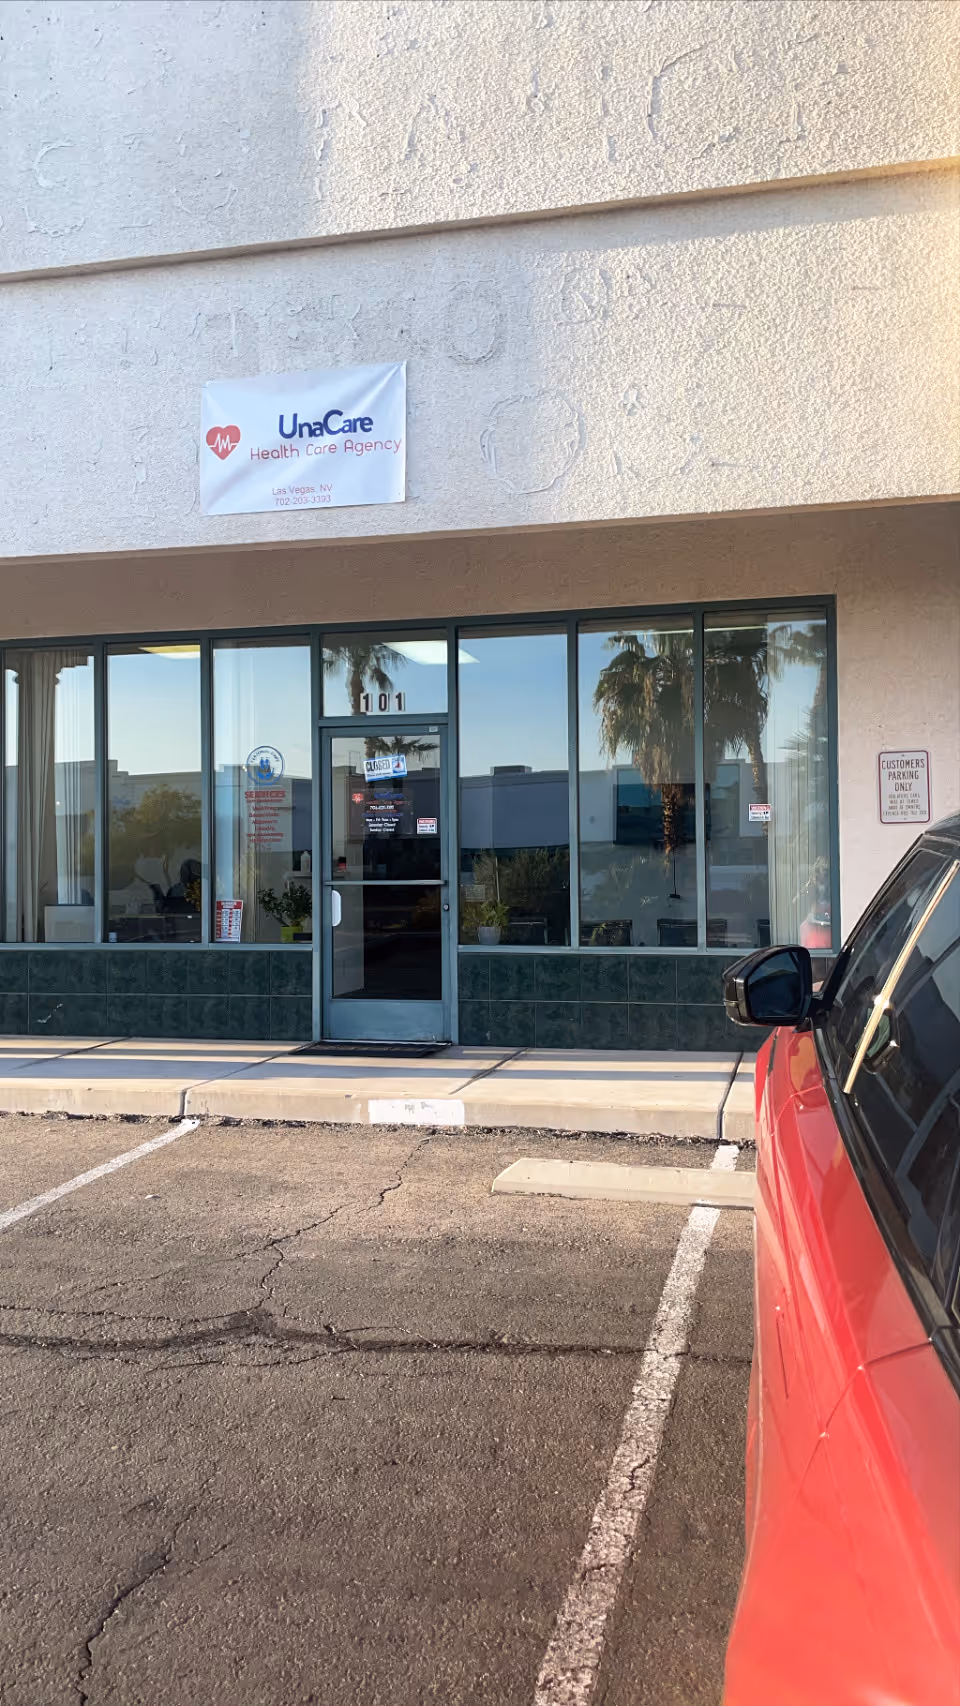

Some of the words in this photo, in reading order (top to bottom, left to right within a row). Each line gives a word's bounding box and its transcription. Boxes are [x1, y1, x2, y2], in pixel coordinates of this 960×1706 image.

[278, 409, 373, 439] UnaCare
[251, 444, 300, 461] Health
[305, 443, 338, 456] Care
[344, 437, 402, 456] Agency
[272, 486, 287, 496] Las
[320, 484, 333, 493] NV
[365, 759, 391, 773] CLOSED
[882, 759, 925, 770] CUSTOMERS
[888, 770, 919, 781] PARKING
[894, 782, 913, 792] ONLY
